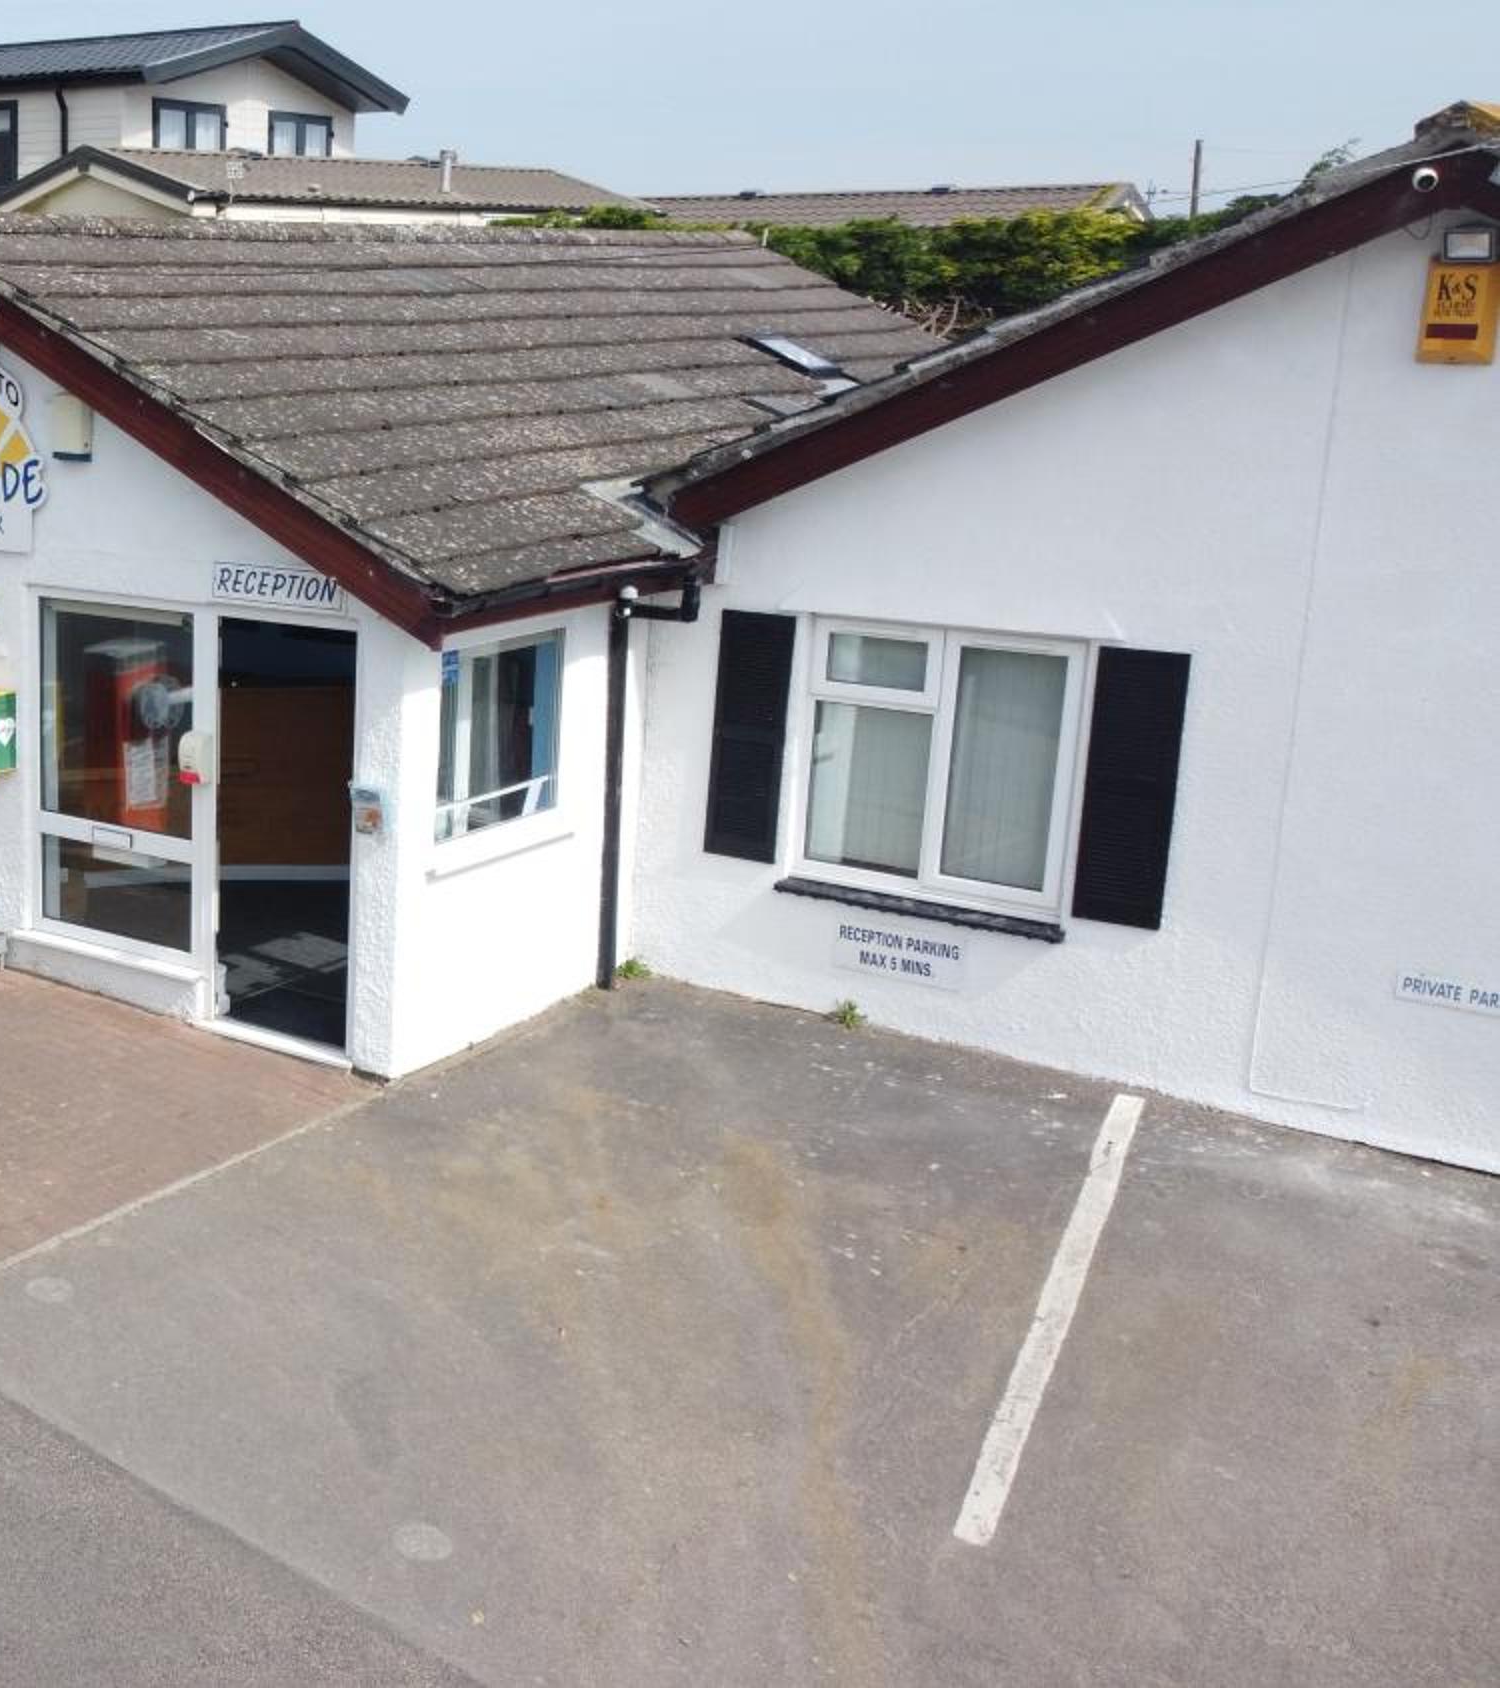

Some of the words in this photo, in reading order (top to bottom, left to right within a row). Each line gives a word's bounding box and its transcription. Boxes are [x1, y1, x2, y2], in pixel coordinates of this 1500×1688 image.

[216, 567, 338, 603] RECEPTION
[839, 925, 902, 949] RECEPTION
[905, 937, 960, 961] PARKING
[859, 950, 887, 969] MAX
[889, 957, 897, 971] 5
[900, 959, 932, 977] MINS
[1402, 977, 1463, 1001] PRIVATE
